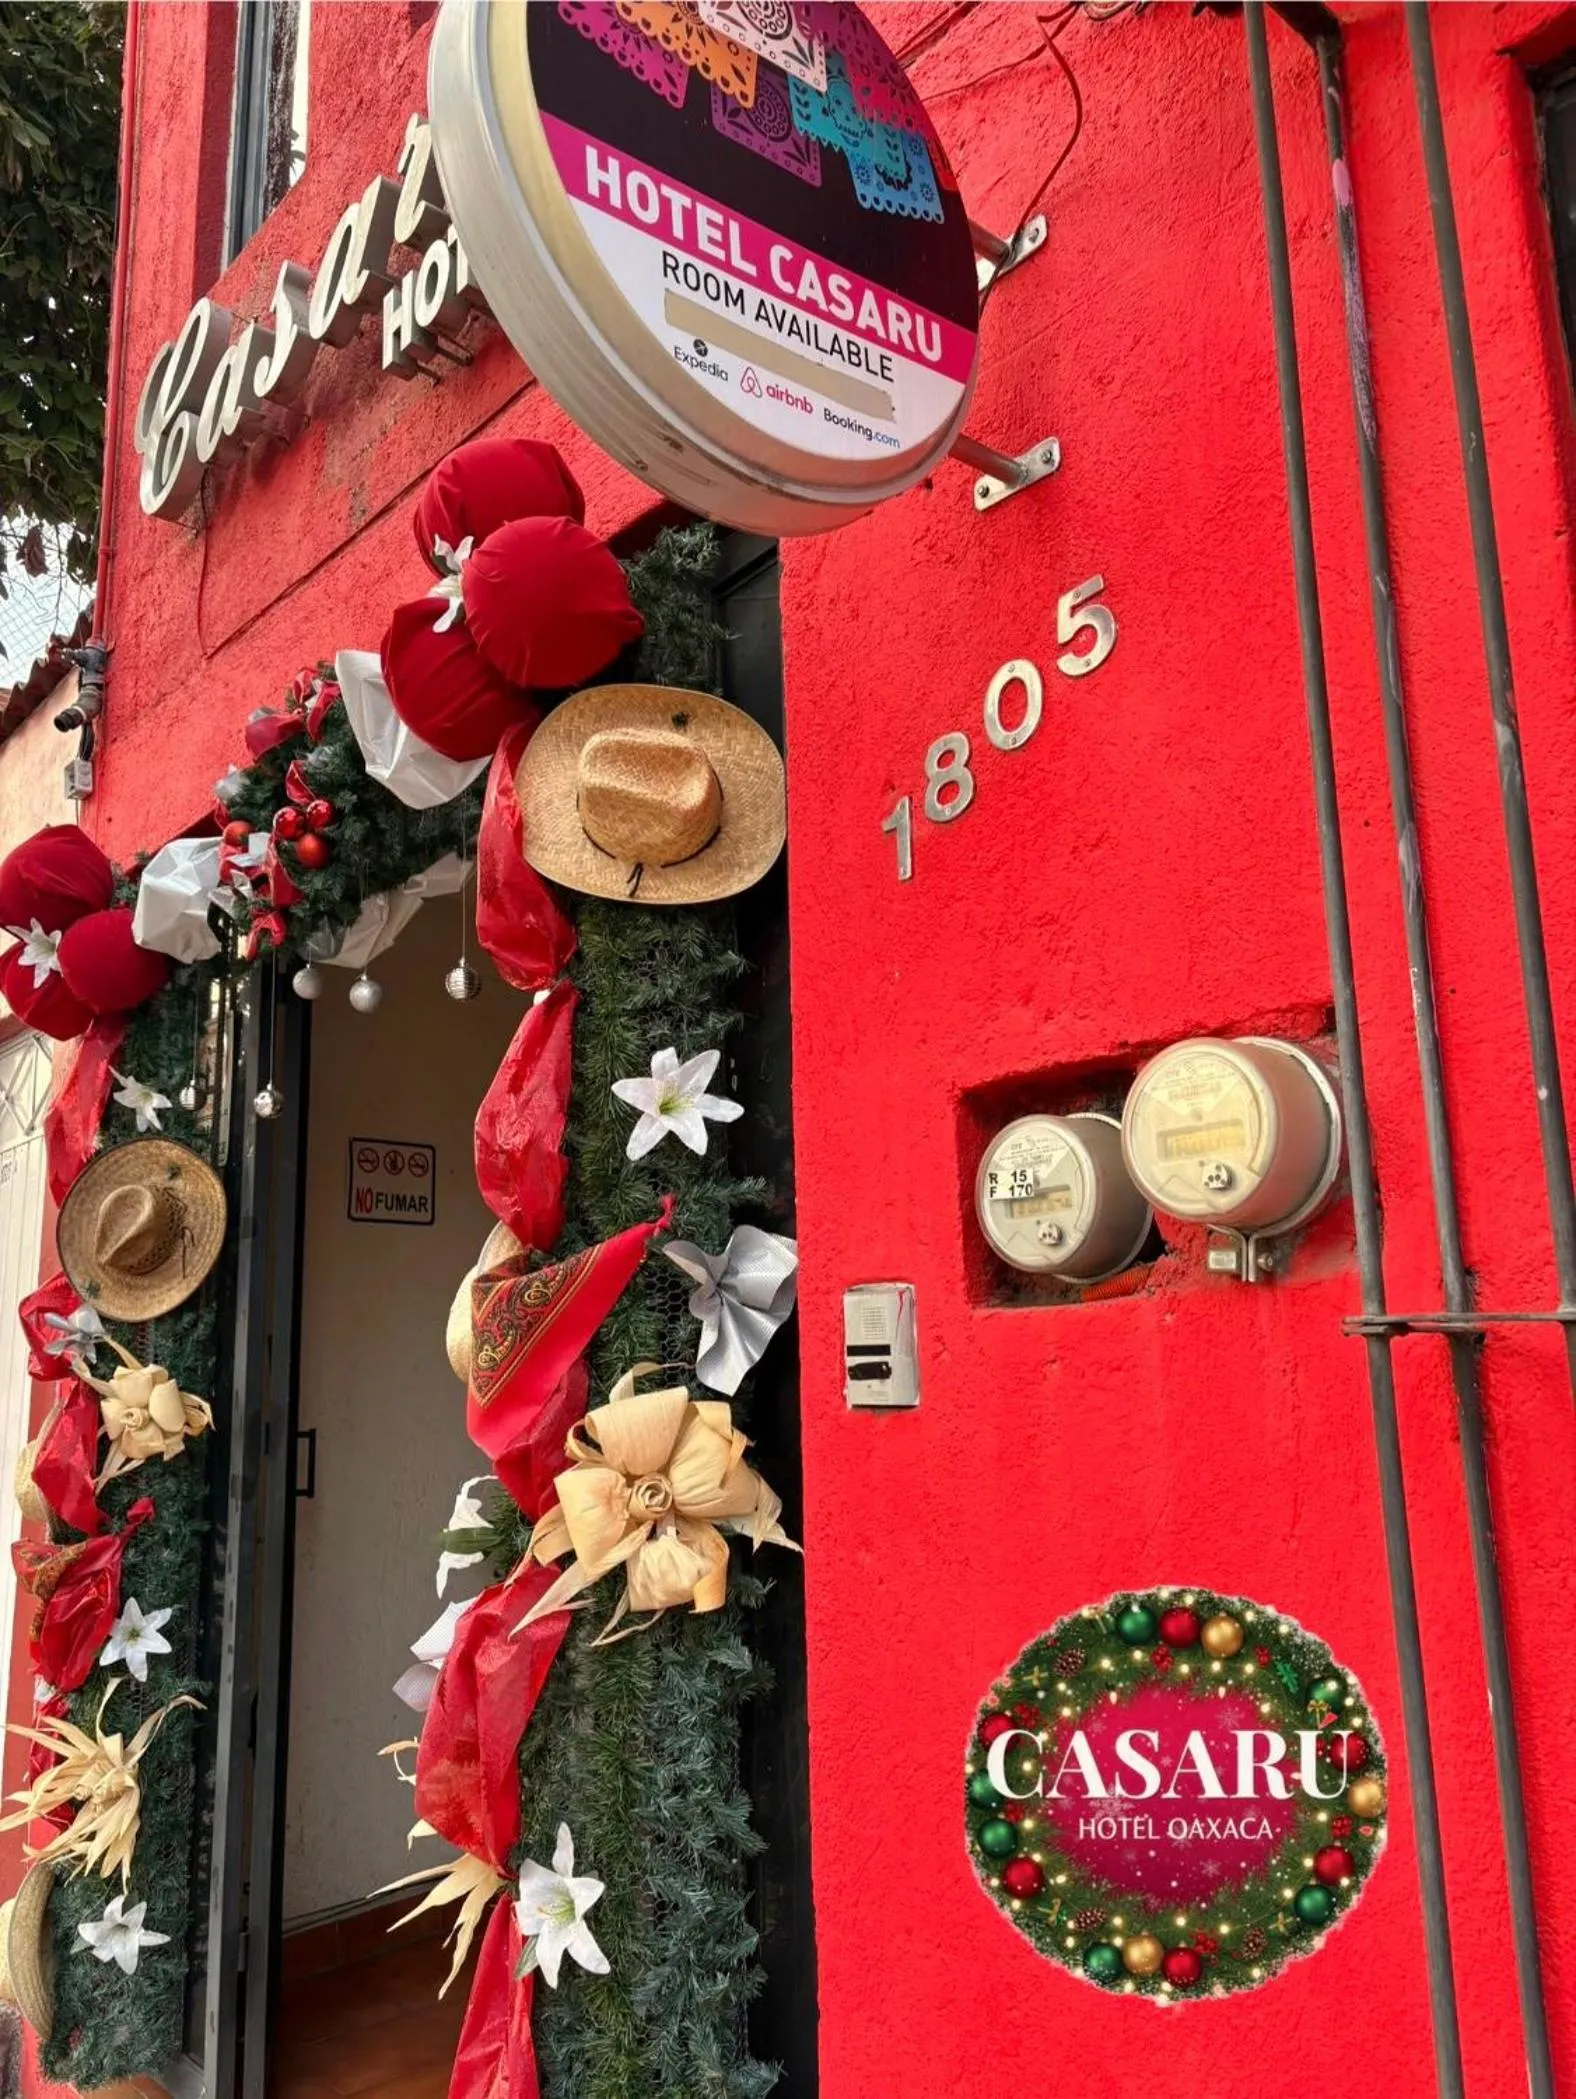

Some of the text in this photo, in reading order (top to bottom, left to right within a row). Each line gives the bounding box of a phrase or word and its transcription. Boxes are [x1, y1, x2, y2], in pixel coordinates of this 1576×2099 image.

[584, 144, 942, 363] HOTEL CASARU
[135, 112, 432, 515] Casar
[382, 224, 469, 370] HOT
[662, 250, 895, 384] ROOM AVAILABLE
[673, 346, 729, 382] Expedia
[765, 384, 814, 415] airbnb
[823, 407, 900, 449] Booking.com
[881, 573, 1117, 881] 1805
[988, 1169, 1027, 1184] R 15
[989, 1183, 1033, 1198] F 170
[355, 1187, 429, 1213] NO FUMAR
